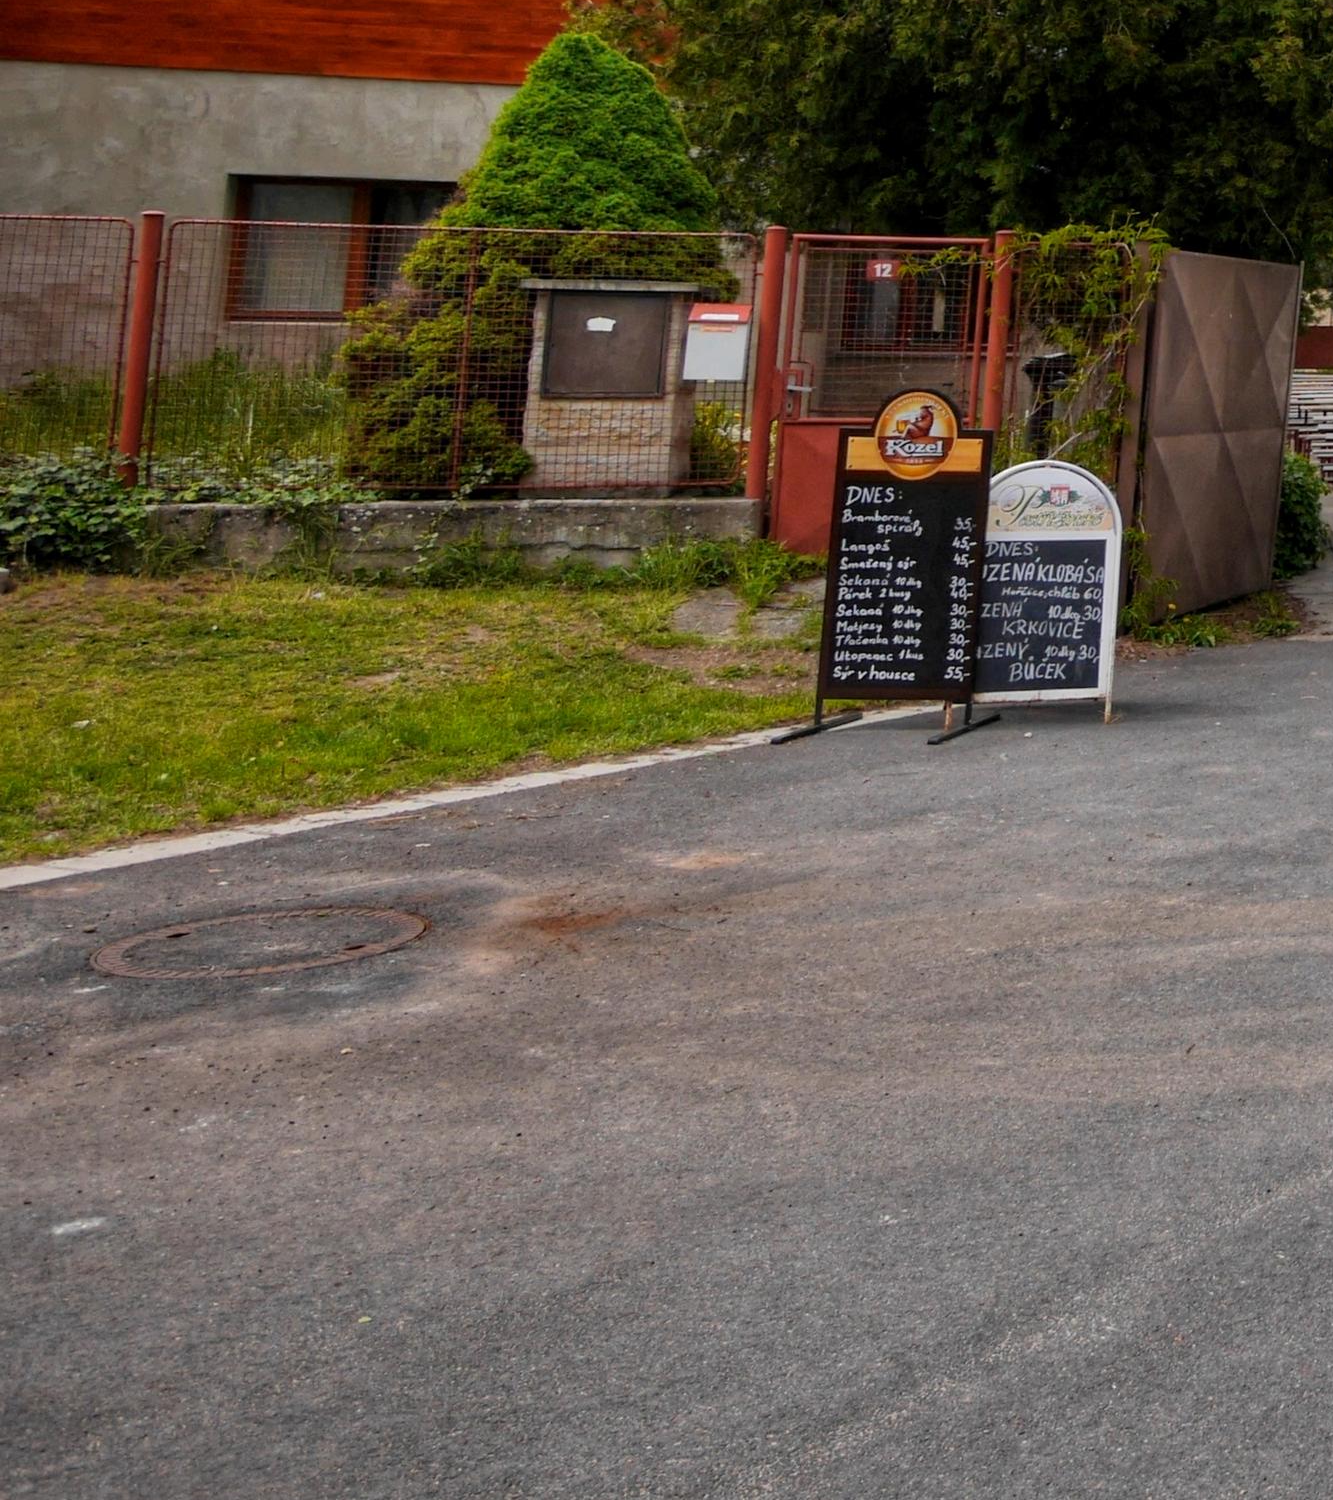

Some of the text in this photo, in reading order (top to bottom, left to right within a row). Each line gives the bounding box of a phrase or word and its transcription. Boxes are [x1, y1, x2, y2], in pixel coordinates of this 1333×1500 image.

[874, 263, 892, 277] 12
[885, 440, 944, 456] Kozel
[841, 538, 891, 554] Langoš
[839, 556, 893, 571] Smažený
[897, 557, 917, 570] sýr
[838, 573, 891, 586] Sekaná
[838, 587, 872, 600] Párek
[835, 603, 884, 617] Sekaná
[836, 621, 883, 634] Matjesy
[1001, 619, 1086, 639] KRKOVICE
[976, 638, 1029, 660] ZENÝ
[834, 651, 893, 662] Utopenec
[833, 665, 855, 680] Sýr
[858, 671, 867, 679] v
[869, 664, 916, 681] housce
